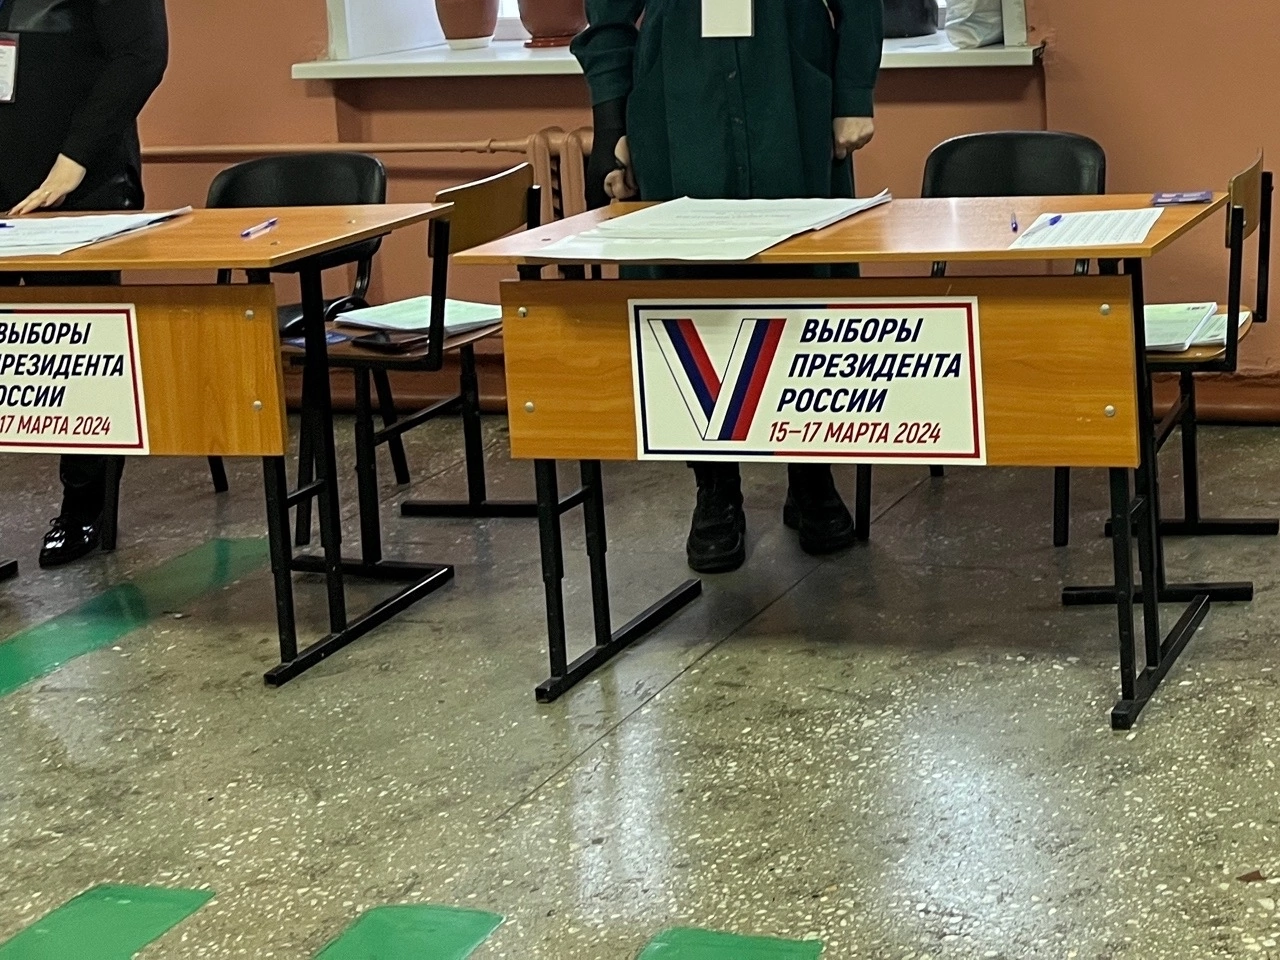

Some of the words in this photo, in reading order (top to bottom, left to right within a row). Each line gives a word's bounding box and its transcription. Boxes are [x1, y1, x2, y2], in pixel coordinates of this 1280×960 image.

[799, 318, 924, 343] ВЫБОРЫ
[0, 354, 125, 380] РЕЗИДЕНТА
[788, 353, 962, 382] ПРЕЗИДЕНТА
[0, 385, 66, 407] ОССИИ
[776, 388, 889, 413] РОССИИ
[16, 415, 69, 435] МАРТА
[72, 416, 111, 435] 2024
[824, 422, 890, 444] МАРТА
[893, 422, 942, 444] 2024
